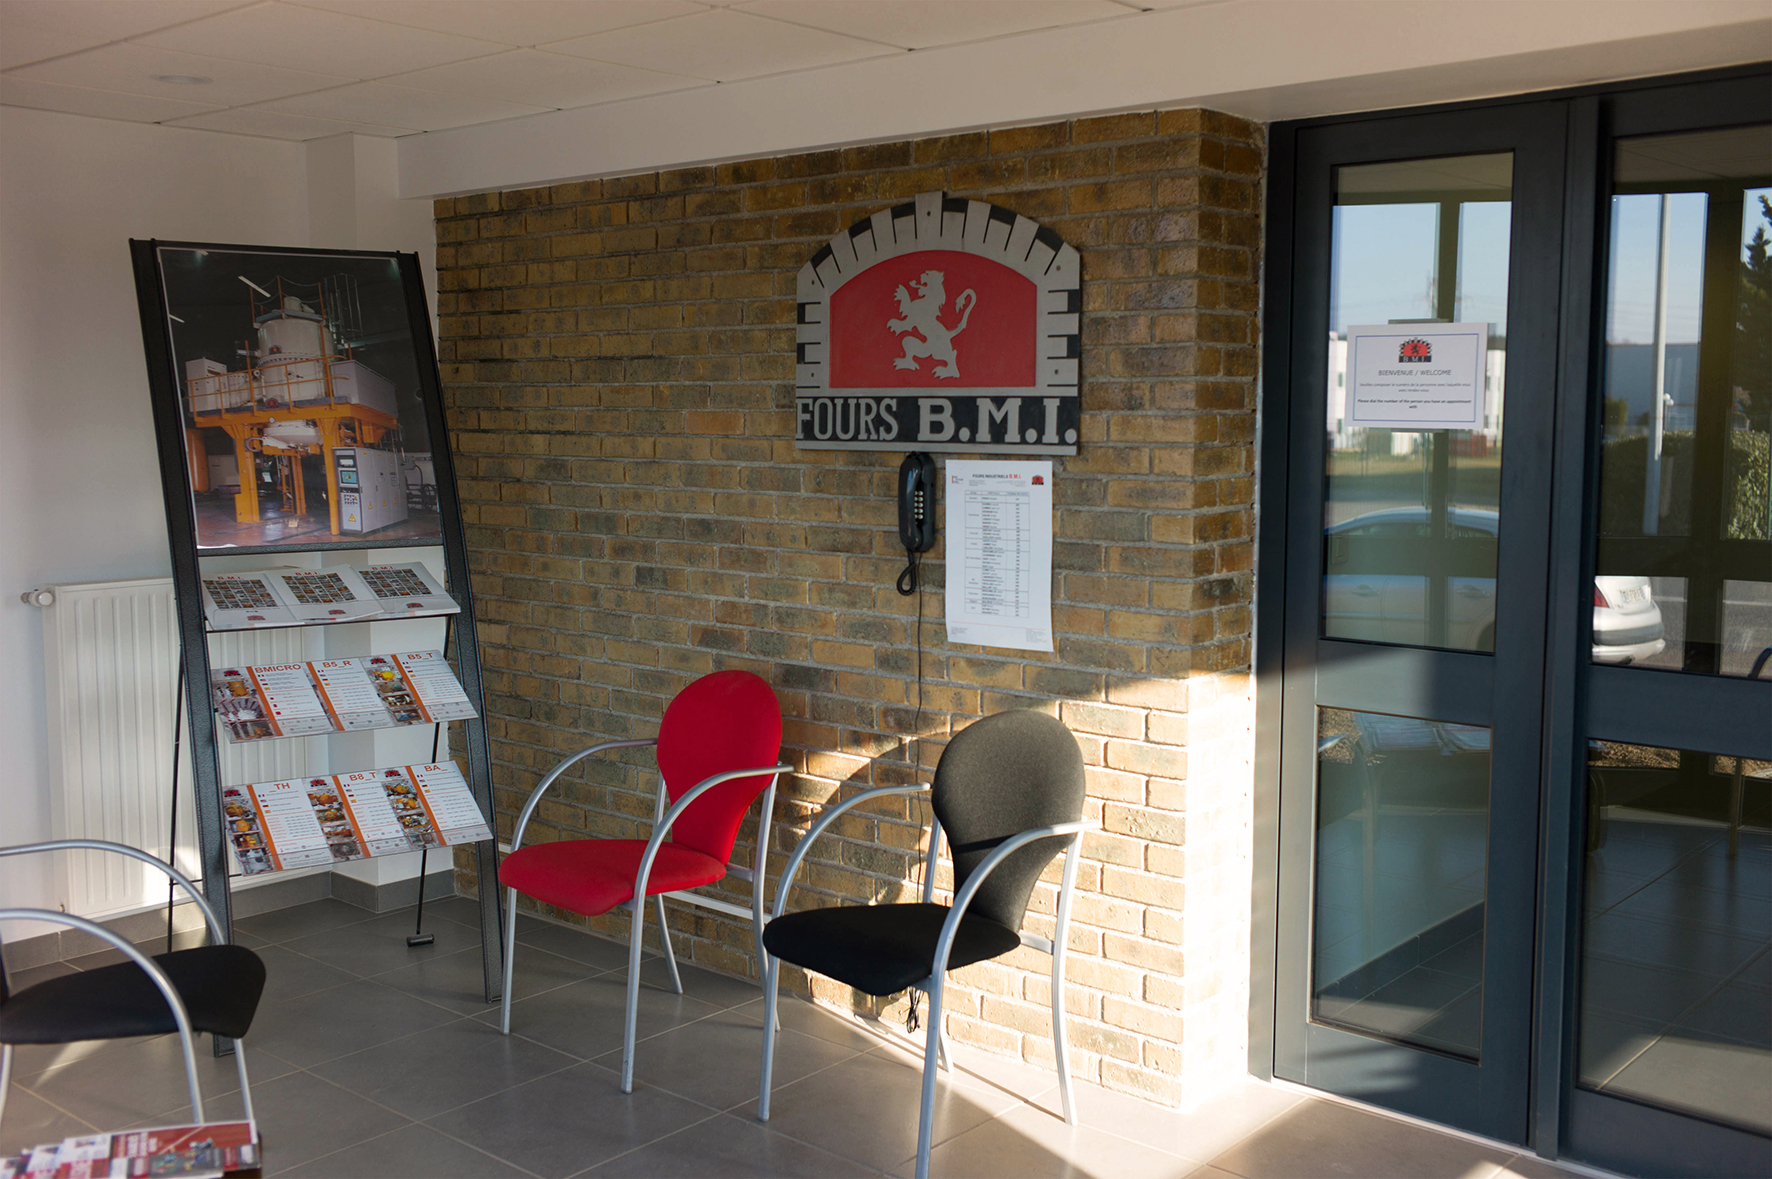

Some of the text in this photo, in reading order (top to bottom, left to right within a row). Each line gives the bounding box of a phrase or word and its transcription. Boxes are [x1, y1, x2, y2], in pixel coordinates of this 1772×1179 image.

[796, 397, 1078, 444] FOURS B.M.I.
[254, 664, 301, 673] BMICRO
